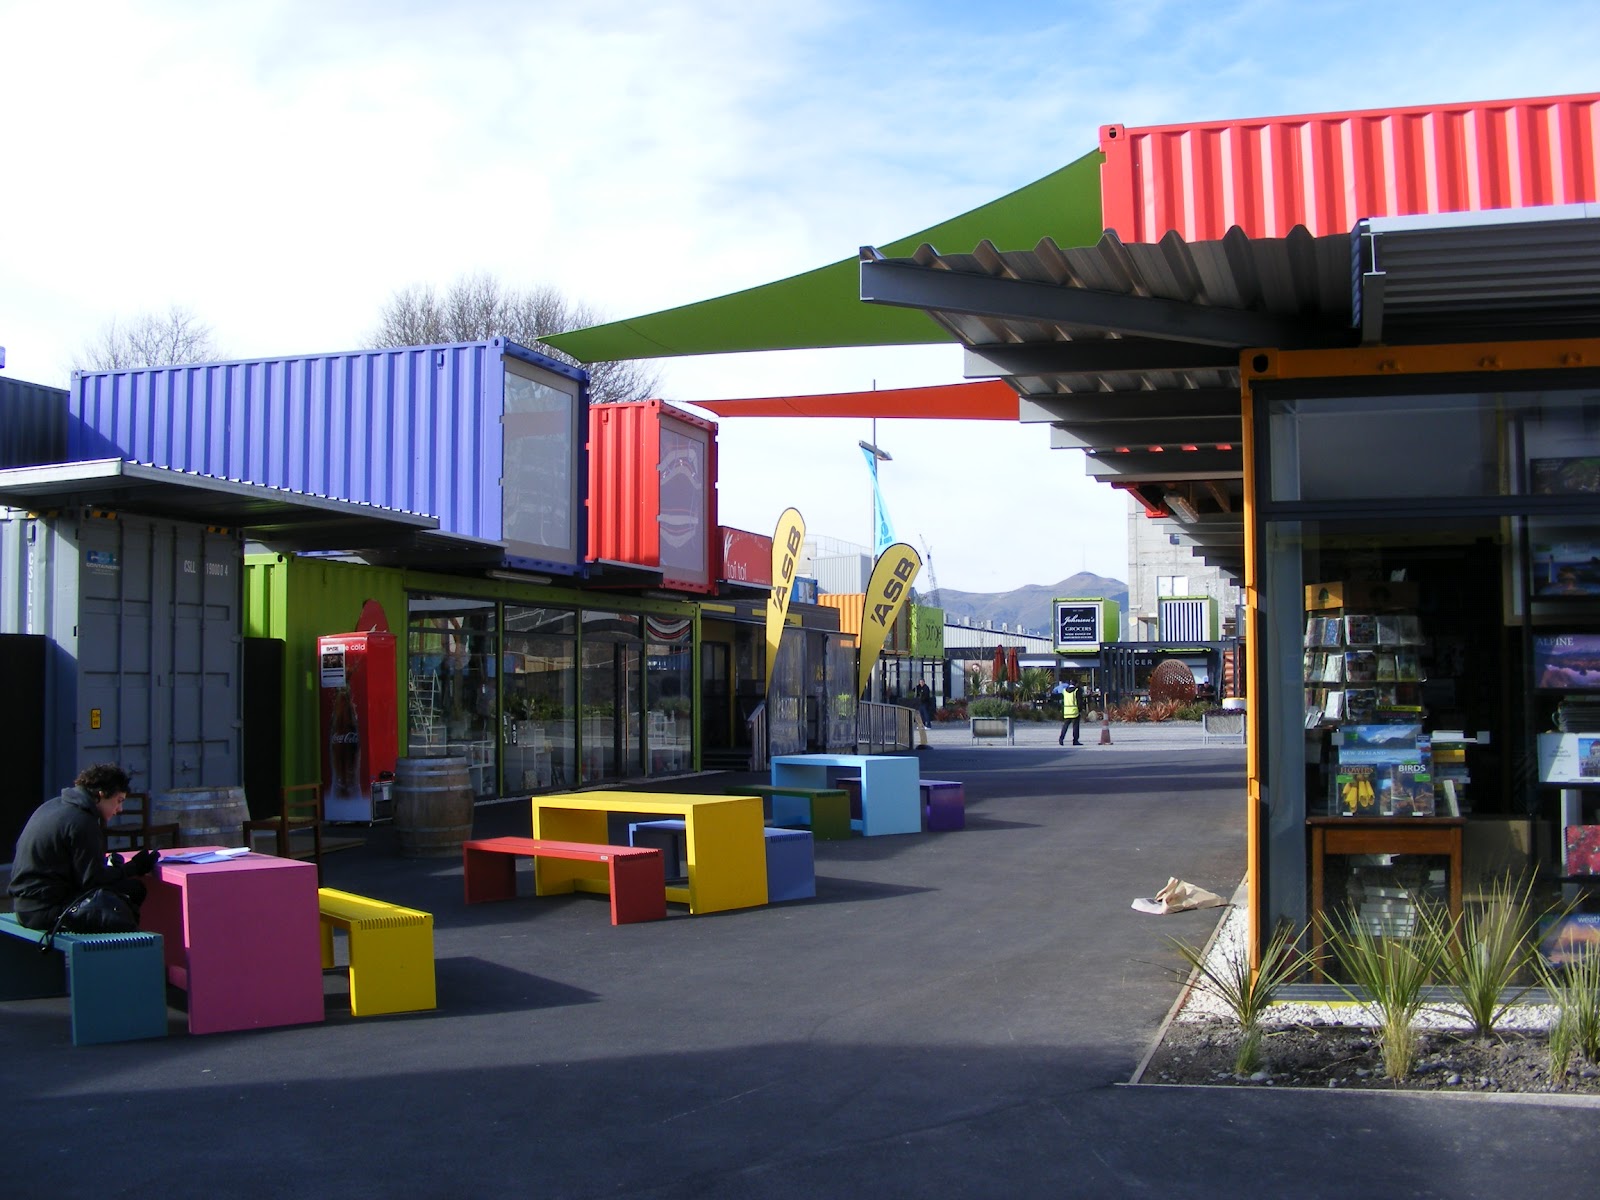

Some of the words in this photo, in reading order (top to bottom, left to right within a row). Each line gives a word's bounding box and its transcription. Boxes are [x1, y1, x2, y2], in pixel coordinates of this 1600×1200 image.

[773, 525, 802, 614] ASB
[870, 557, 915, 627] ASB
[1061, 614, 1095, 626] Johnson's
[1536, 637, 1574, 646] ALPINE
[350, 643, 366, 651] cold
[1398, 764, 1426, 772] BIRDS
